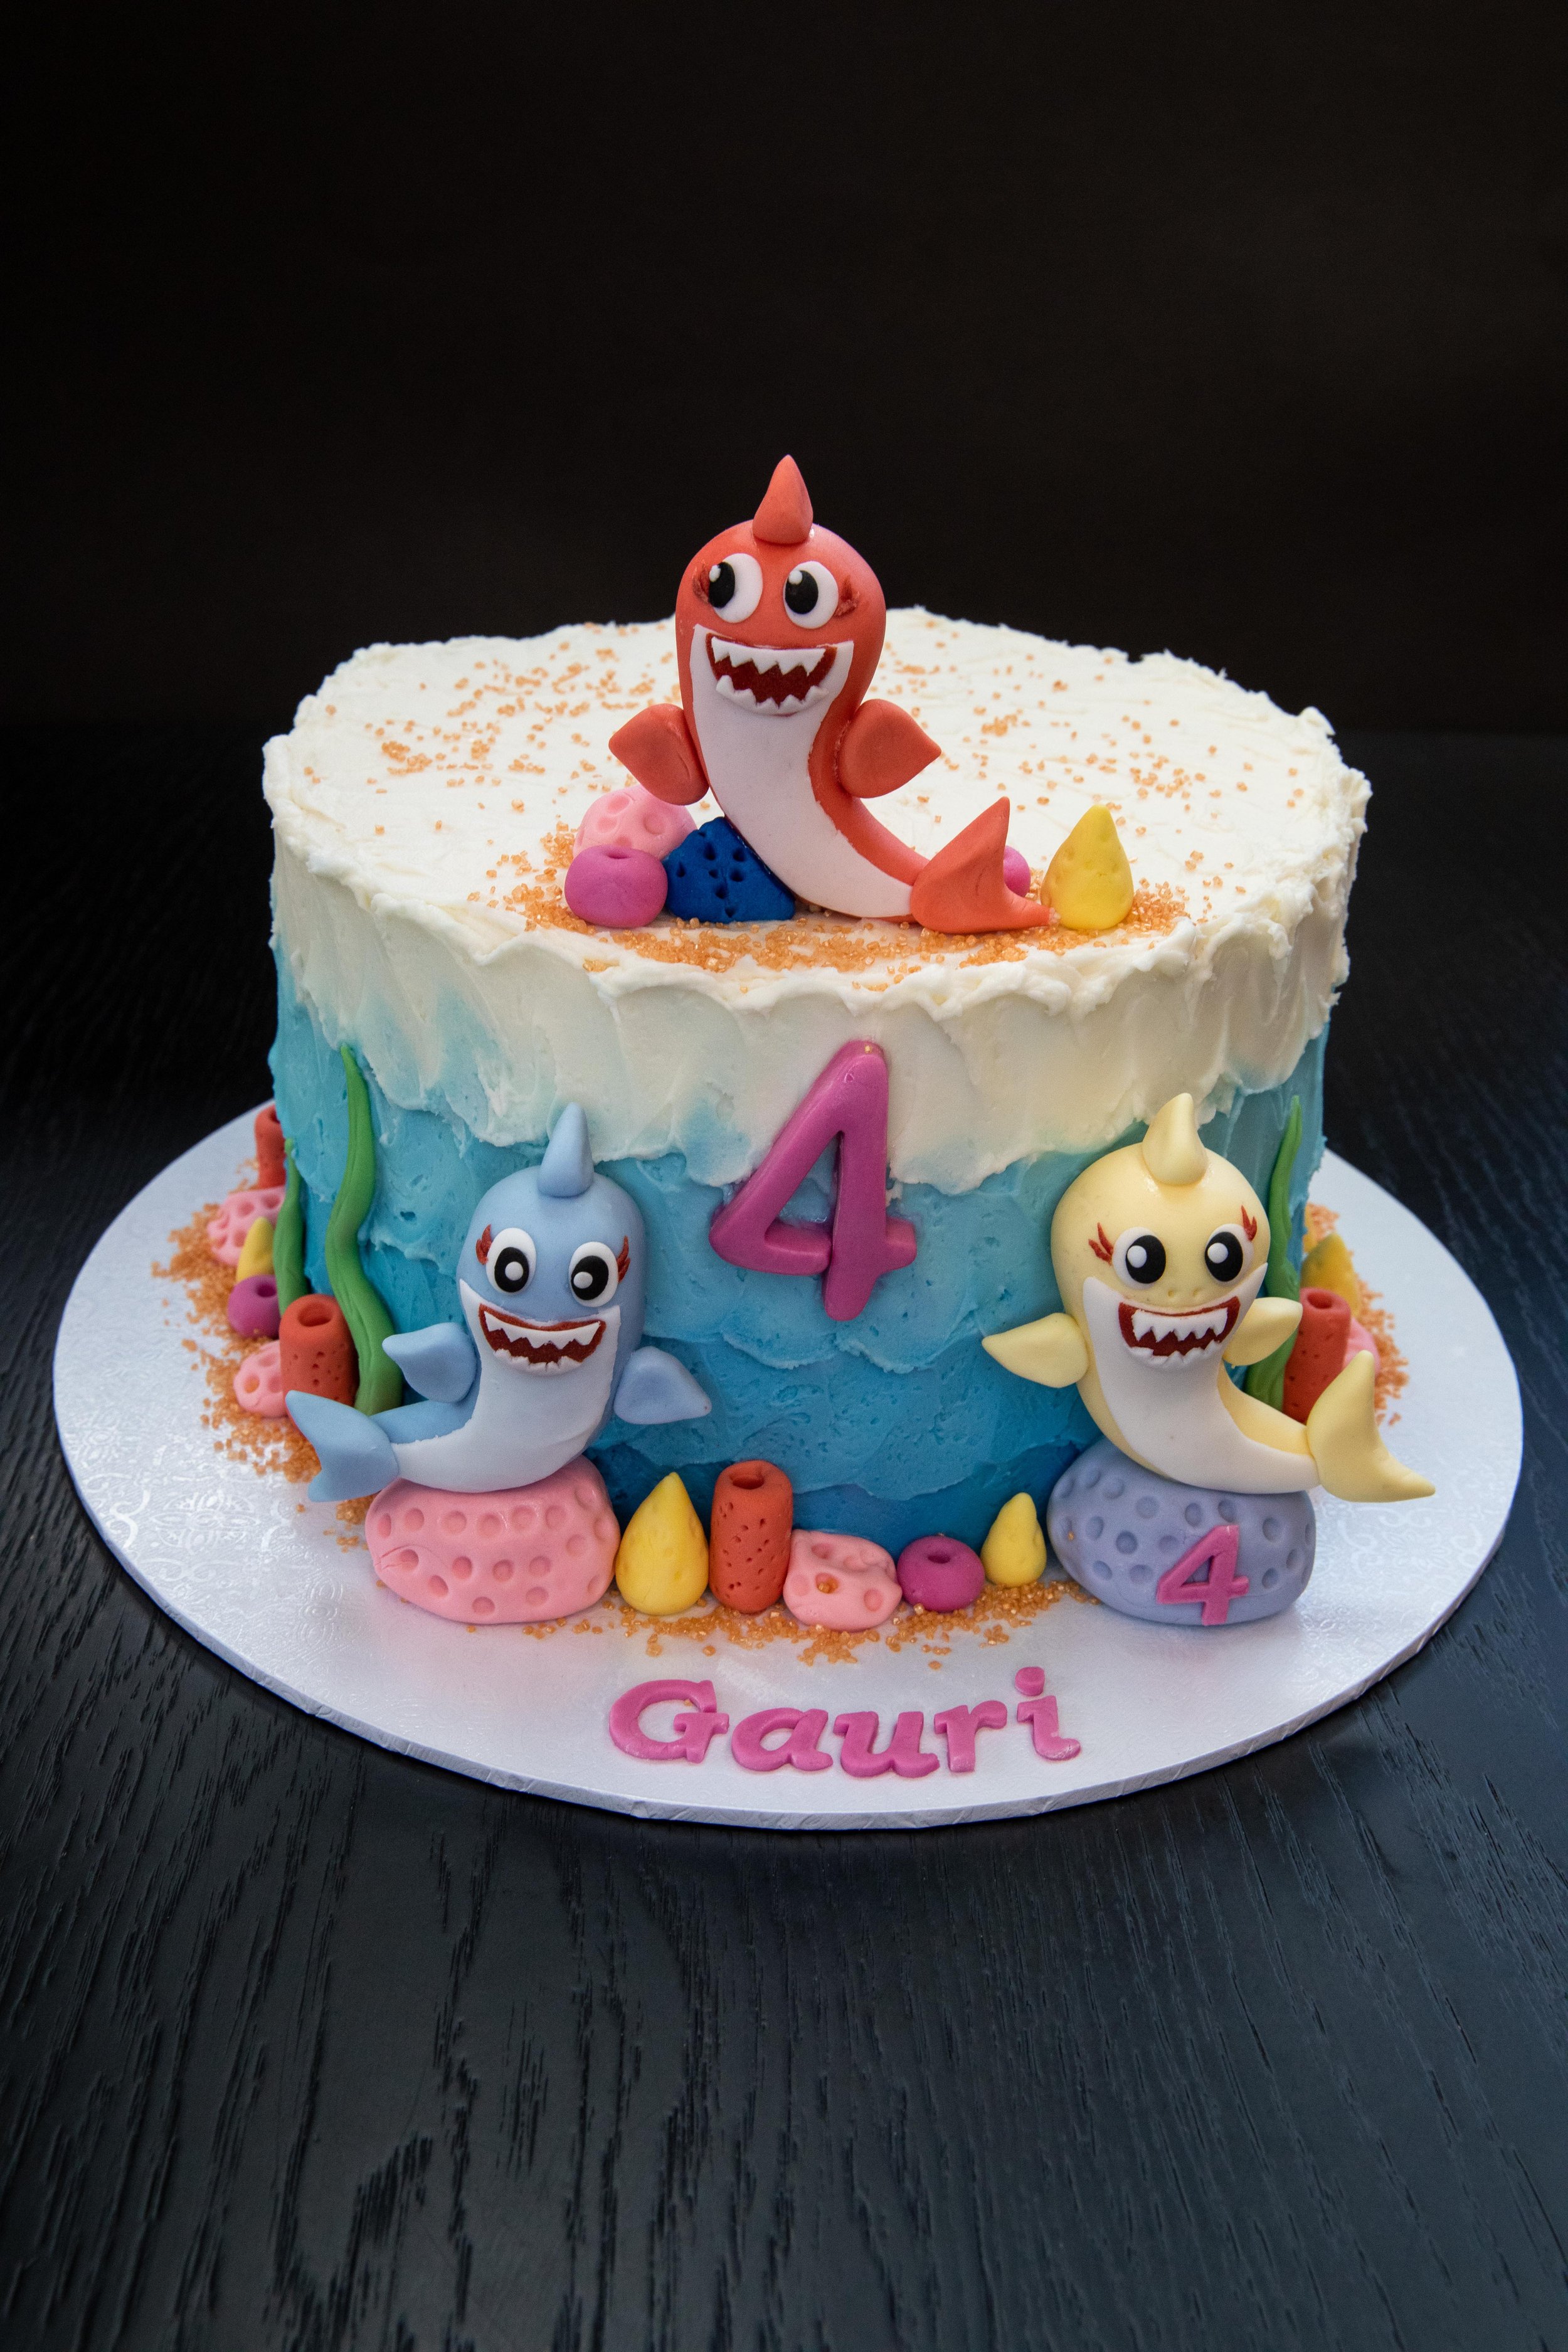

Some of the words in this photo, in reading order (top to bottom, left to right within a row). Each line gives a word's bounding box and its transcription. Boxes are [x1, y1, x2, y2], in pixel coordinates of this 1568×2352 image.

[709, 1039, 918, 1321] 4
[1157, 1525, 1249, 1626] 4
[608, 1666, 1081, 1779] Gauri
